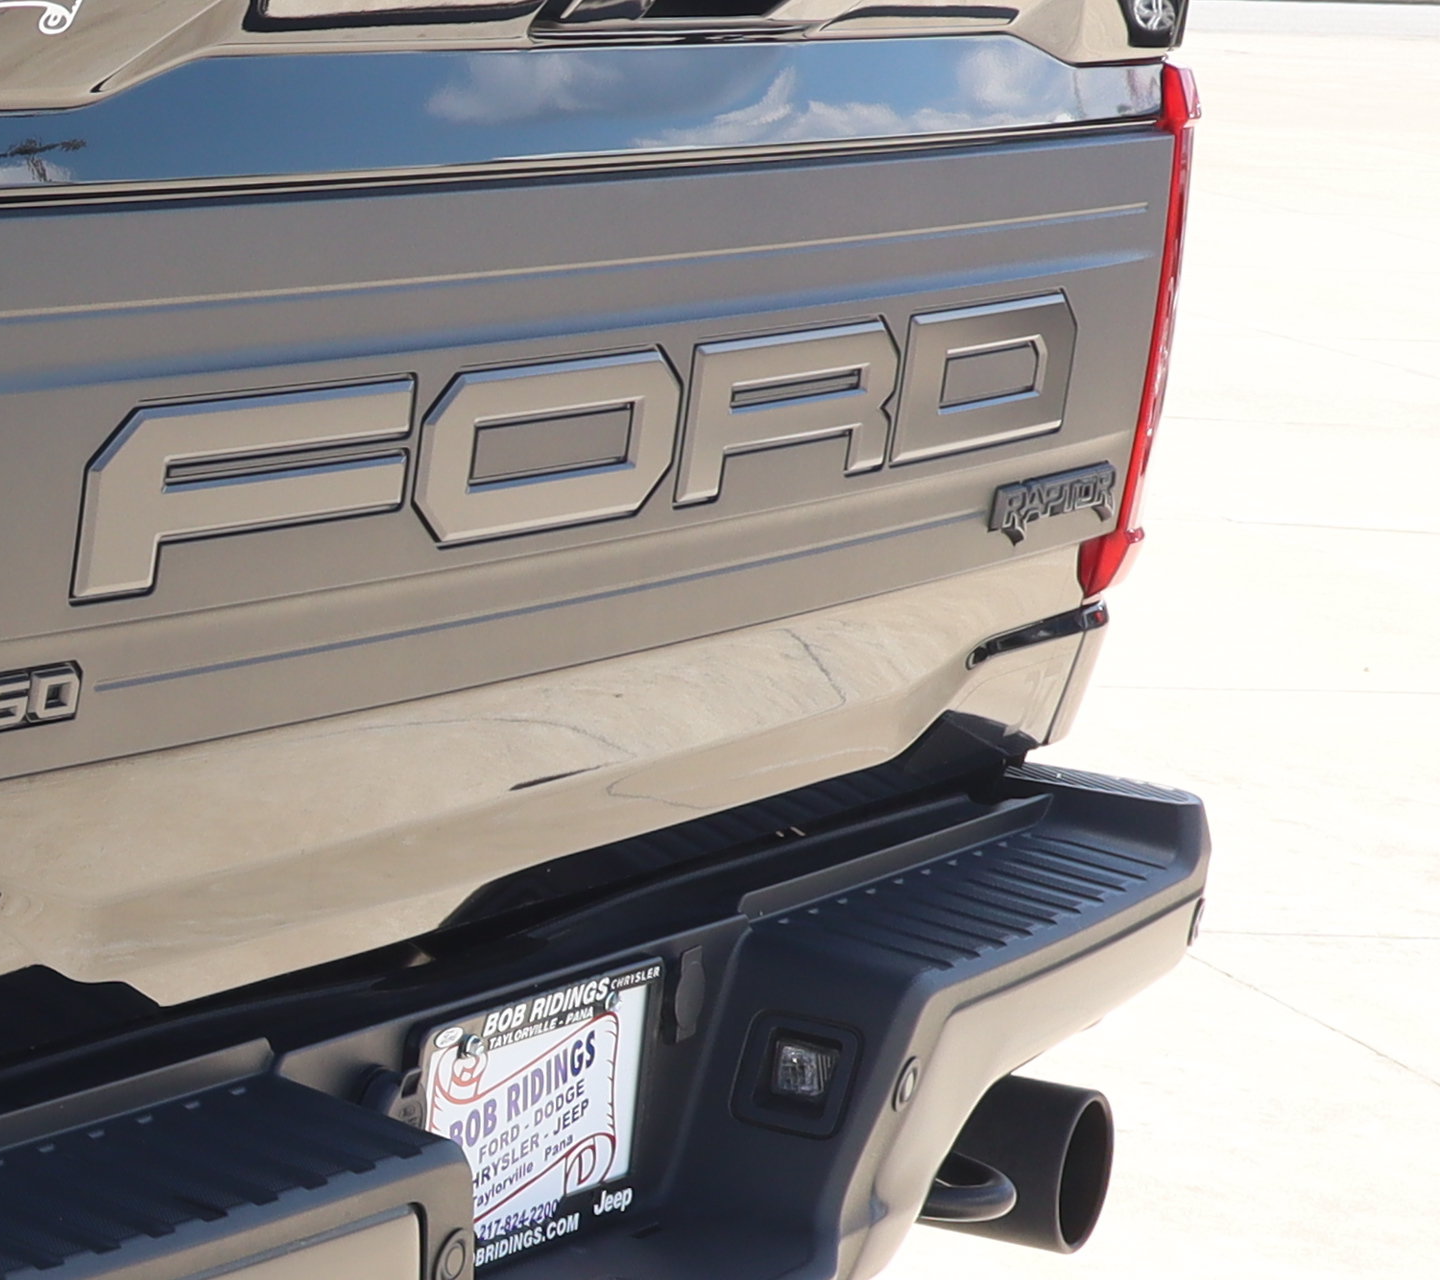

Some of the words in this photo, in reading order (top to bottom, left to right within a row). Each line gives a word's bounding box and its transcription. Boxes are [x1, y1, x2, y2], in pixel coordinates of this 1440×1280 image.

[68, 289, 1078, 605] FORD
[988, 460, 1117, 547] RAPTOR
[483, 1004, 527, 1038] BOB
[530, 977, 610, 1022] RIDINGS
[611, 966, 660, 989] CHRYSLER
[488, 1020, 557, 1050] TAYLORVILLE
[566, 1006, 594, 1026] PANA
[449, 1098, 497, 1148] BOB
[507, 1030, 595, 1122] RIDINGS
[473, 1133, 539, 1188] HRYSLER
[553, 1098, 589, 1135] JEEP
[479, 1123, 520, 1164] FORD
[534, 1079, 585, 1127] DODGE
[545, 1135, 573, 1161] Pana
[594, 1187, 632, 1215] Jeep
[473, 1213, 580, 1267] BRIDINGS.COM
